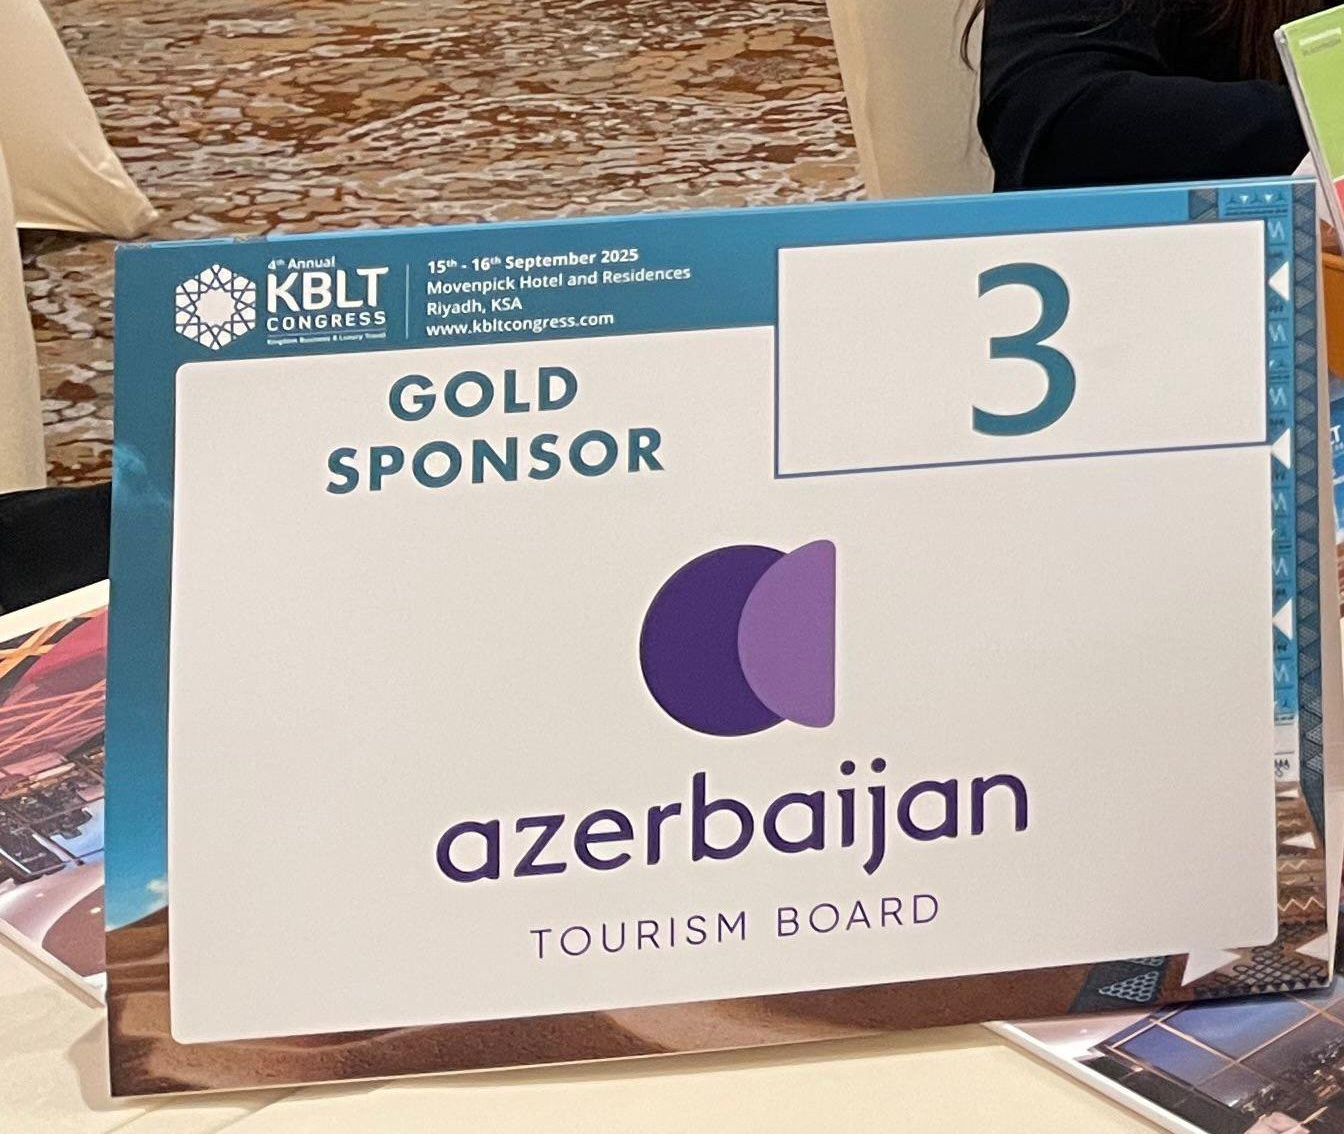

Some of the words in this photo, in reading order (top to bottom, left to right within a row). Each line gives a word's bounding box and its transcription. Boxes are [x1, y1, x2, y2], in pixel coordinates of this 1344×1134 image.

[288, 256, 336, 269] Annual
[428, 259, 457, 274] 15th
[471, 257, 501, 272] 16th
[505, 251, 597, 272] September
[601, 248, 639, 264] 2025
[266, 266, 389, 313] KBLT
[427, 277, 515, 295] Movenpick
[520, 274, 563, 289] Hotel
[567, 271, 598, 286] and
[603, 267, 691, 284] Residences
[266, 310, 387, 332] CONGRESS
[426, 313, 614, 336] www.kbltcongress.com
[427, 298, 486, 318] Riyadh,
[491, 297, 523, 312] KSA
[972, 262, 1077, 436] 3
[388, 366, 579, 422] GOLD
[326, 427, 665, 495] SPONSOR
[435, 757, 1028, 883] azerbaijan
[529, 910, 749, 959] TOURISM
[777, 893, 939, 937] BOARD
